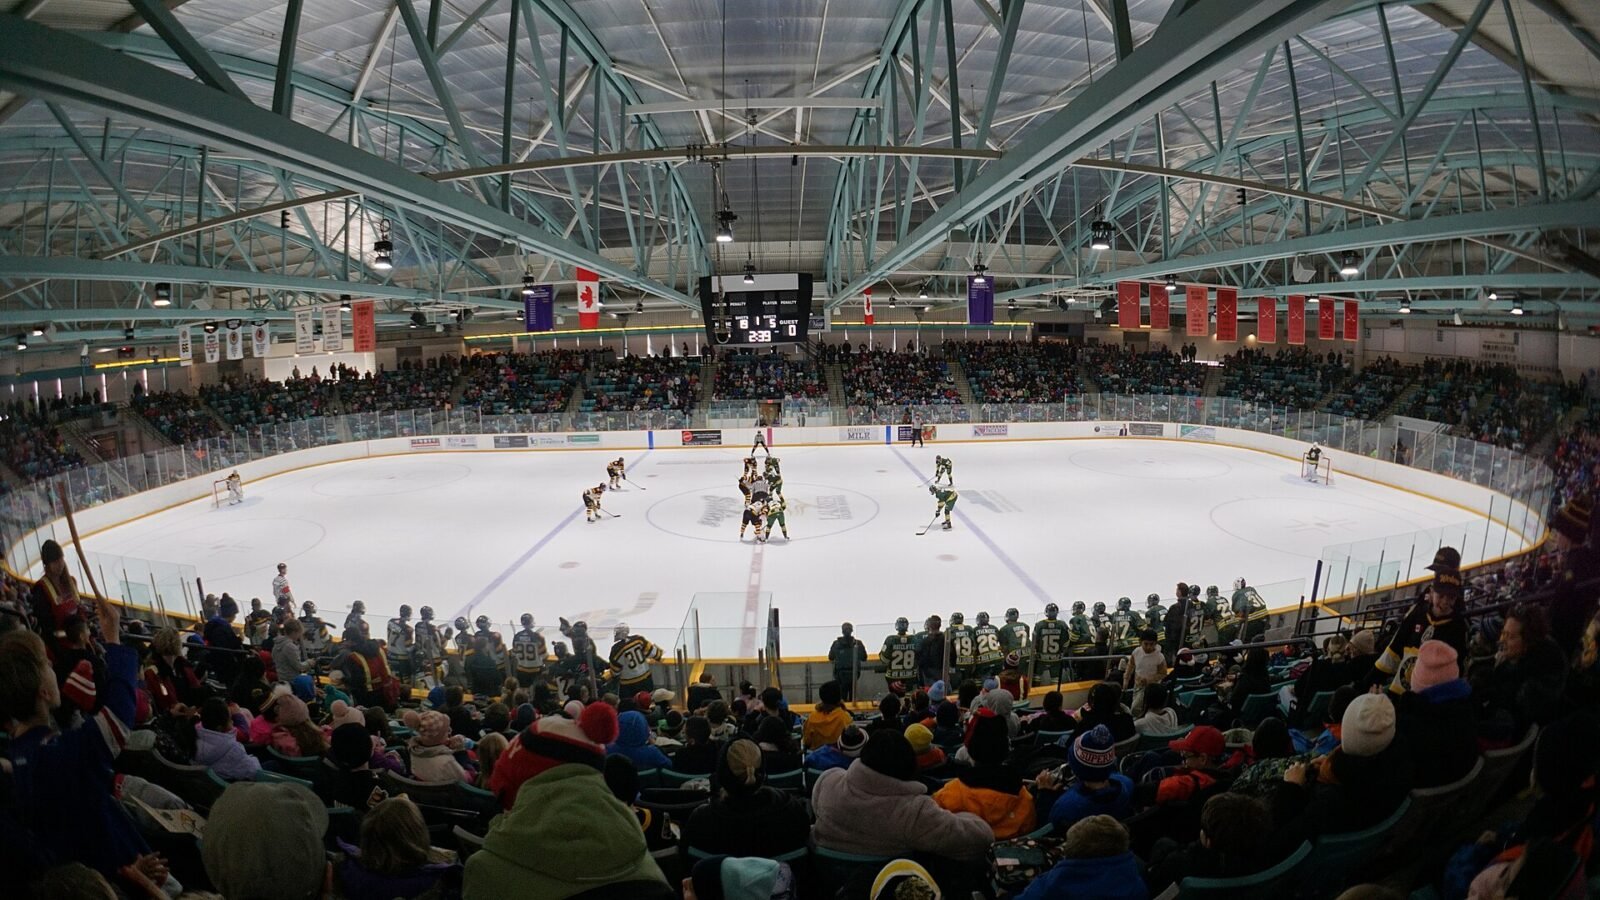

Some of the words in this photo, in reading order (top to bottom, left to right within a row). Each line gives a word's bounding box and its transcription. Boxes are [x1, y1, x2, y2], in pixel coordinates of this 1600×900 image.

[769, 319, 776, 328] 5
[788, 324, 796, 336] 0
[749, 330, 771, 342] 2:39
[848, 432, 870, 440] MILK
[954, 637, 972, 656] 19
[977, 634, 999, 654] 26
[1042, 635, 1060, 654] 15
[625, 646, 645, 670] 30
[891, 650, 915, 669] 28
